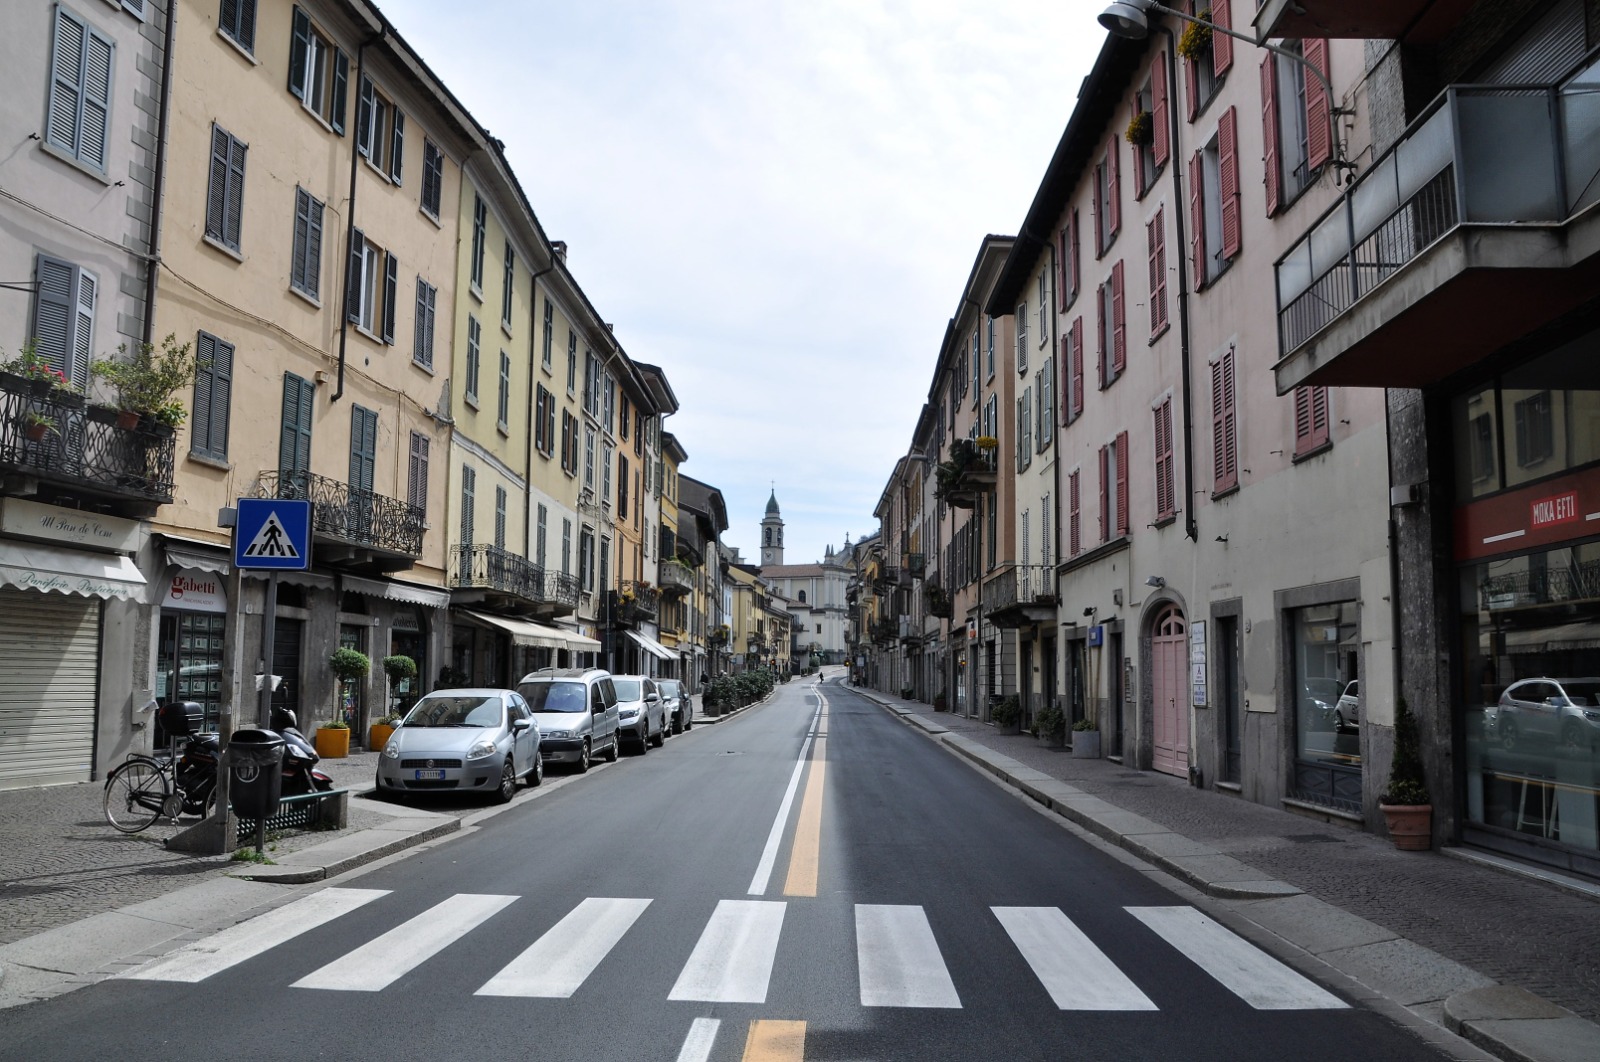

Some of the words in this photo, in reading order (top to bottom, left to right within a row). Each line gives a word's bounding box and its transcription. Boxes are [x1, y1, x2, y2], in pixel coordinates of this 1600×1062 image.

[1533, 501, 1555, 525] MOKA
[1556, 495, 1574, 520] EFTI
[56, 518, 76, 532] Pan
[79, 523, 90, 534] de
[19, 571, 69, 590] Panificio
[171, 576, 215, 600] gabetti
